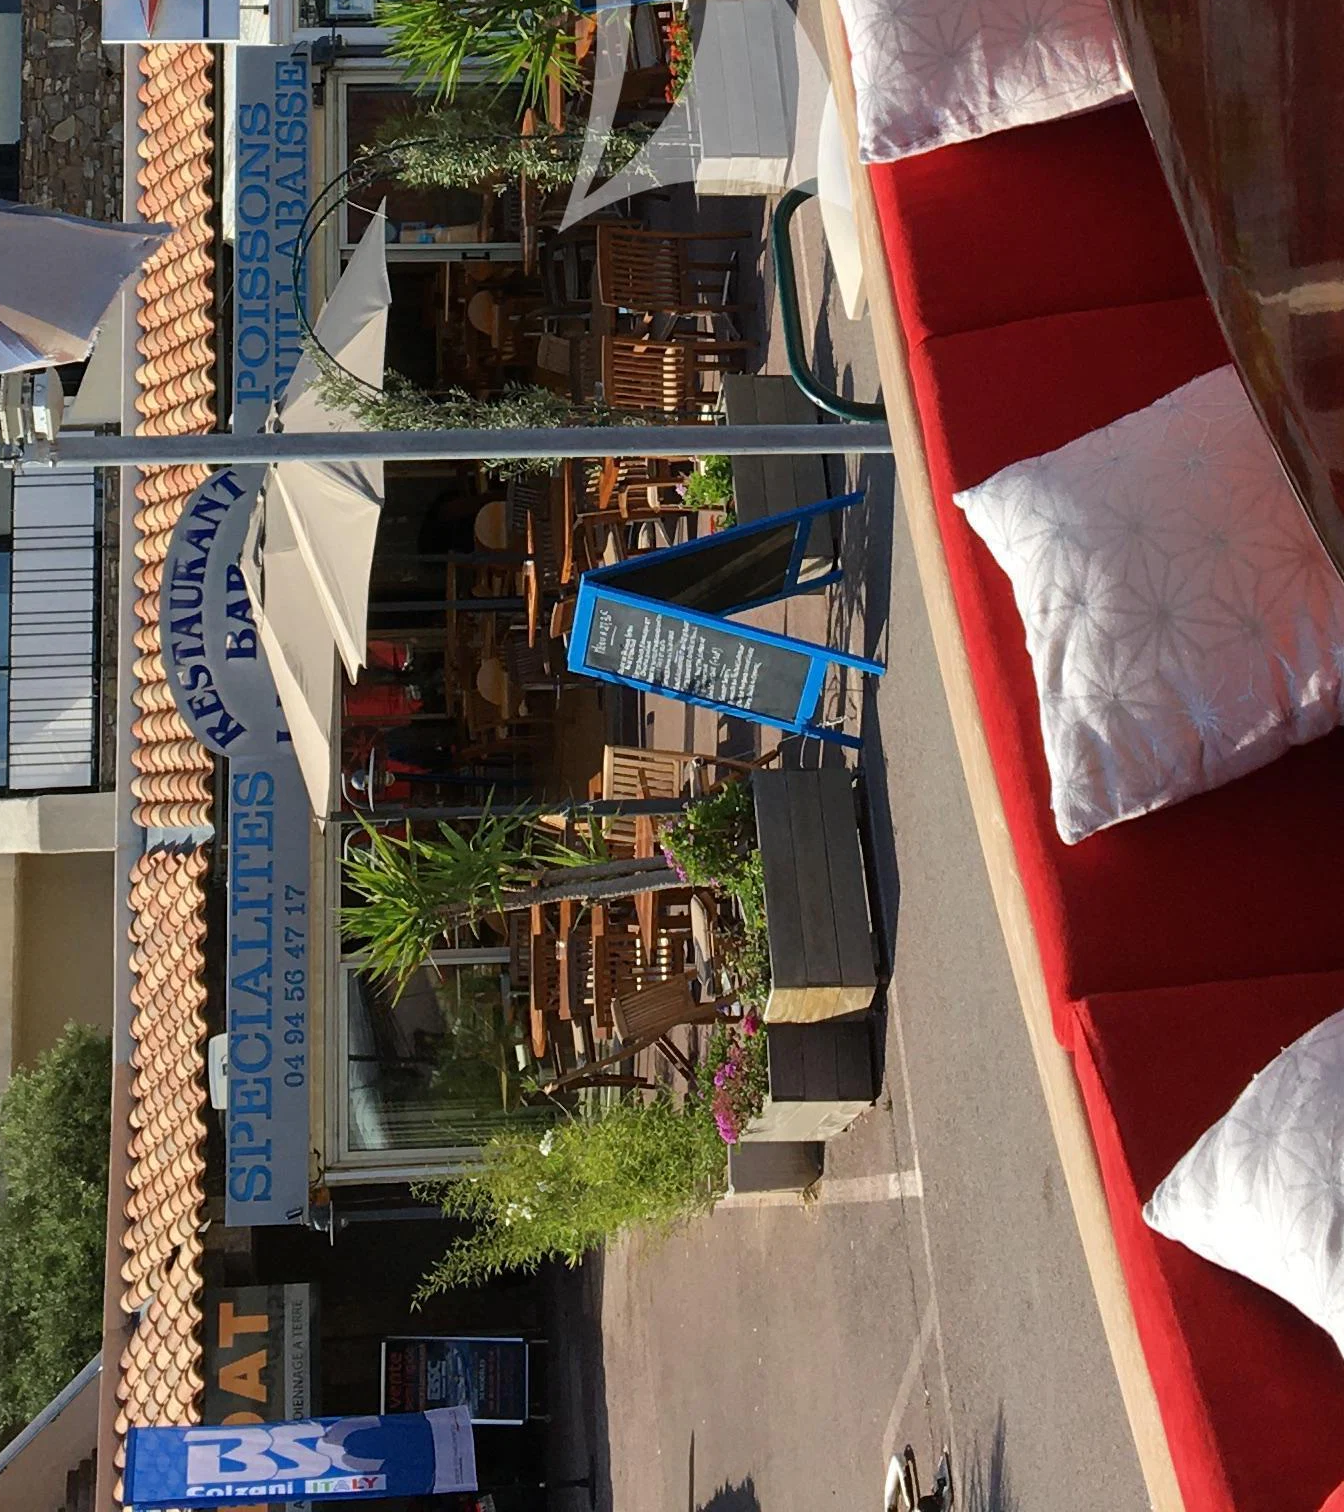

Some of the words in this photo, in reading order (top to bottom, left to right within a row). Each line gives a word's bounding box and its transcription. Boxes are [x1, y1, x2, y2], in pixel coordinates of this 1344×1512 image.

[236, 102, 271, 405] POISSONS
[273, 60, 308, 400] UILLABAISSE
[169, 470, 248, 750] RESTAURANT
[225, 563, 257, 660] BAR
[283, 884, 305, 915] 17
[283, 927, 305, 960] 47
[228, 771, 275, 1202] SPECIALITES
[283, 969, 305, 1002] 56
[283, 1012, 305, 1045] 94
[283, 1054, 305, 1088] 04
[293, 1299, 304, 1337] TERRE
[293, 1353, 304, 1420] DIENNAGE
[388, 1351, 403, 1409] vente
[182, 1415, 385, 1485] BSC
[312, 1476, 378, 1493] ITALY
